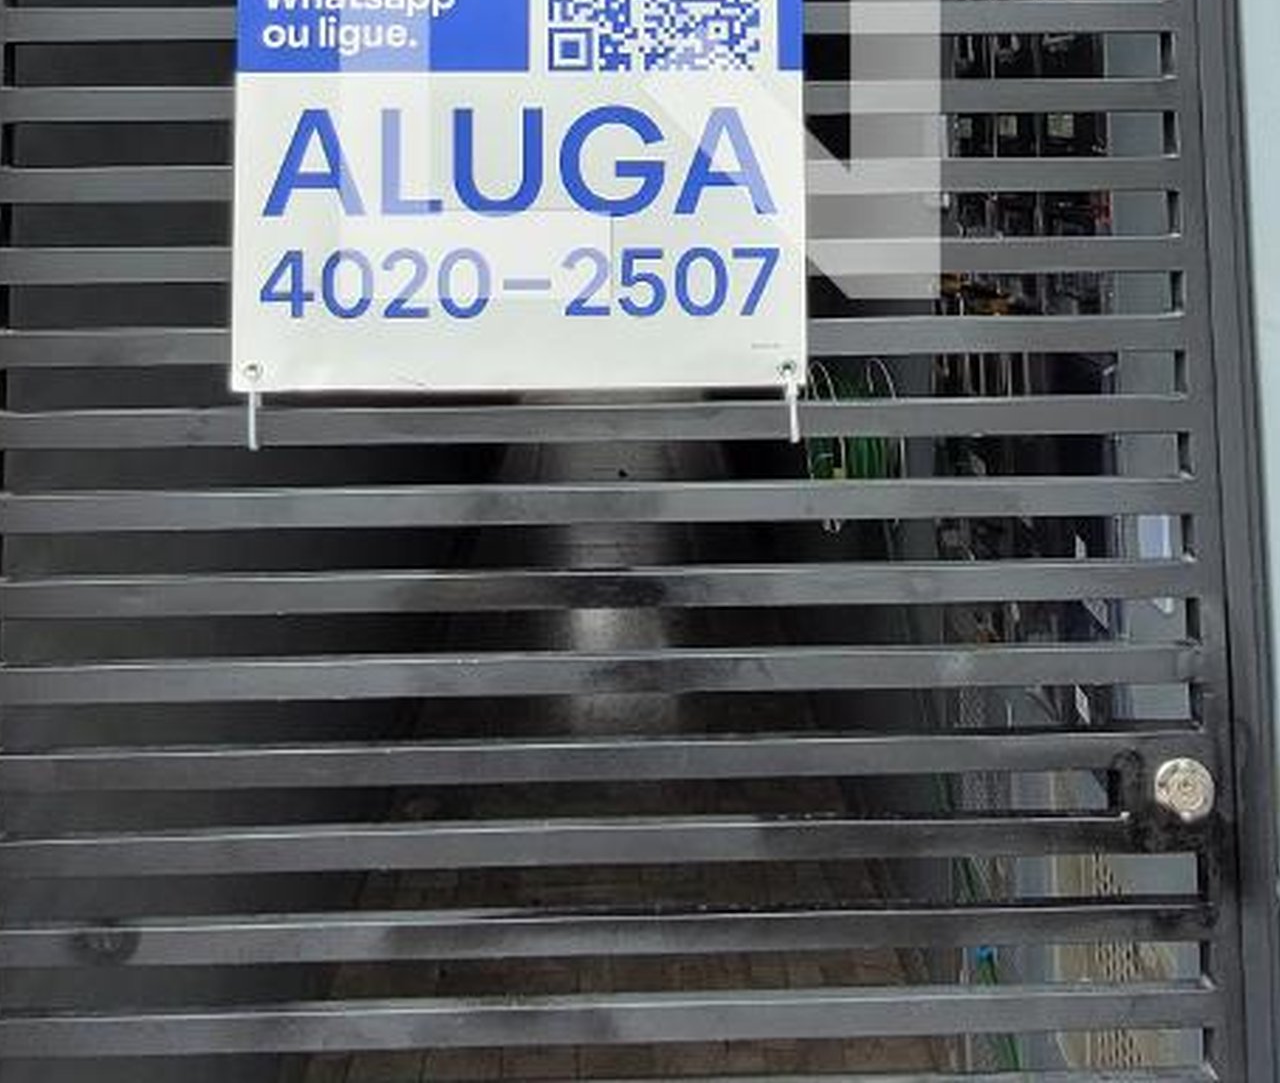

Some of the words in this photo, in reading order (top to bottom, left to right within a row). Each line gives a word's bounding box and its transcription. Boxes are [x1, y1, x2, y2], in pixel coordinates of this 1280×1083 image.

[262, 26, 310, 49] ou
[320, 17, 419, 56] ligue.
[261, 104, 780, 218] ALUGA
[259, 246, 782, 320] 4020-2507
